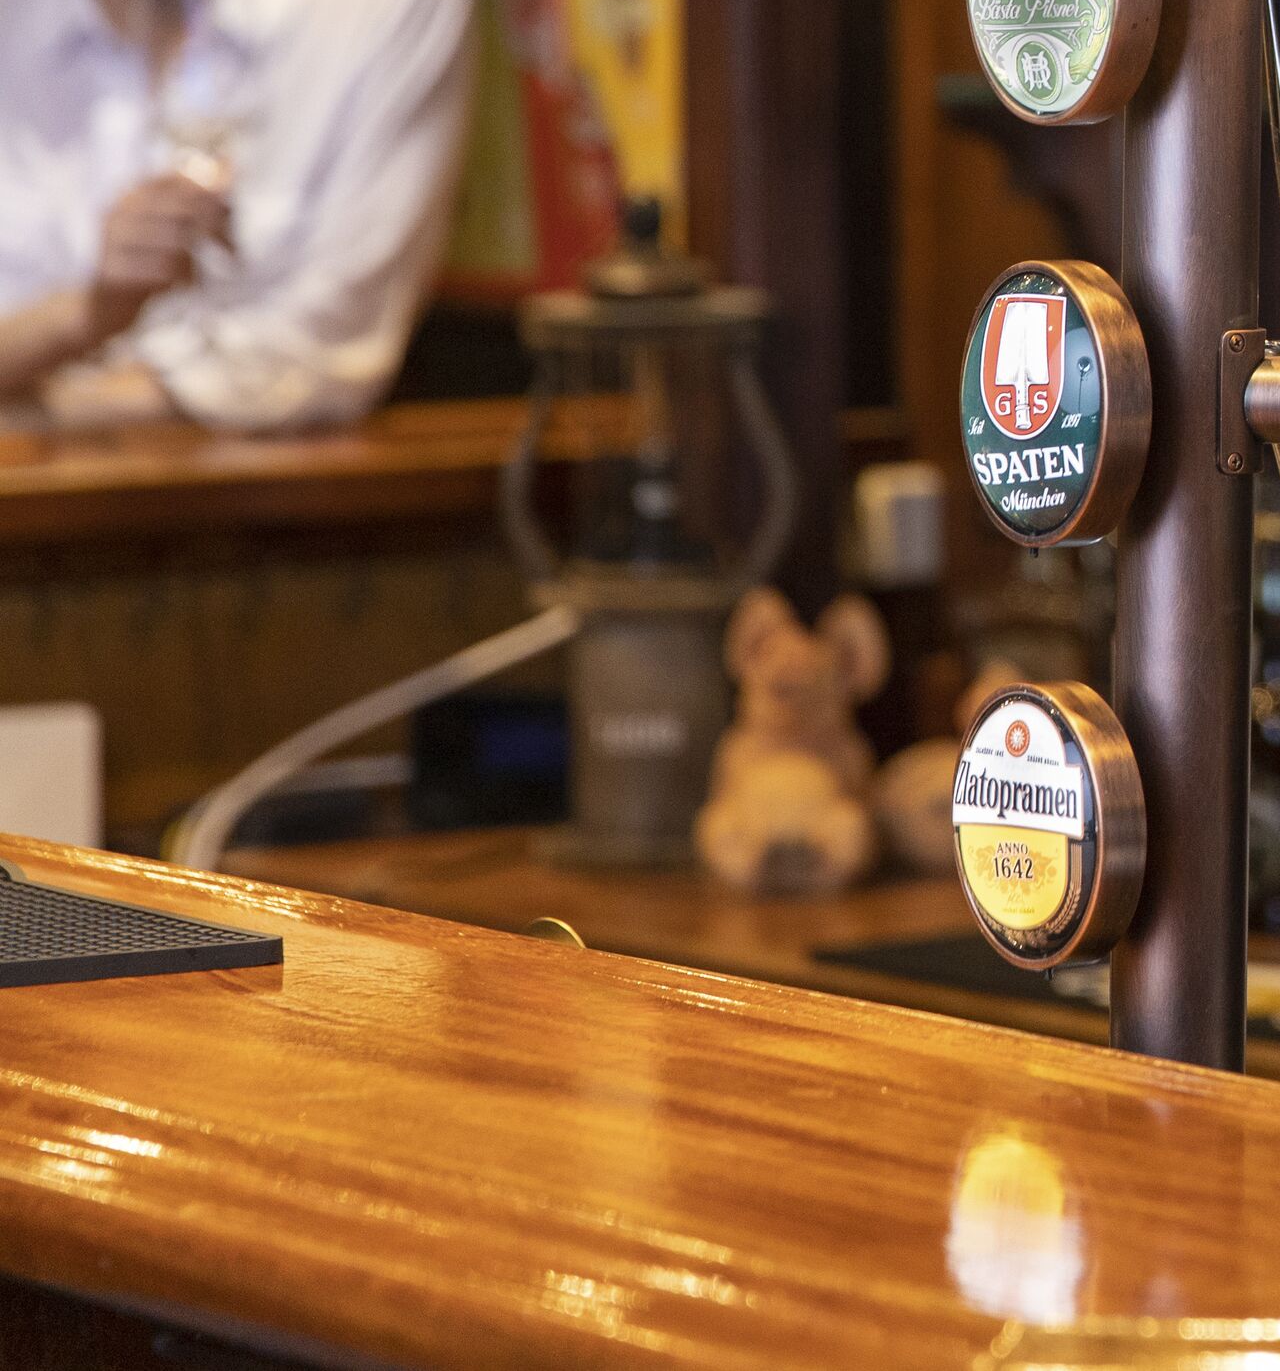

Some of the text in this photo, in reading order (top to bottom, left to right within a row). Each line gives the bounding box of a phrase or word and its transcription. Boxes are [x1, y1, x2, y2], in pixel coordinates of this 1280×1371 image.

[994, 390, 1049, 416] G S
[973, 443, 1084, 486] SPATEN
[1001, 487, 1066, 512] München
[955, 760, 1077, 820] Zlatopramen
[997, 842, 1029, 856] ANNO
[994, 856, 1034, 879] 1642
